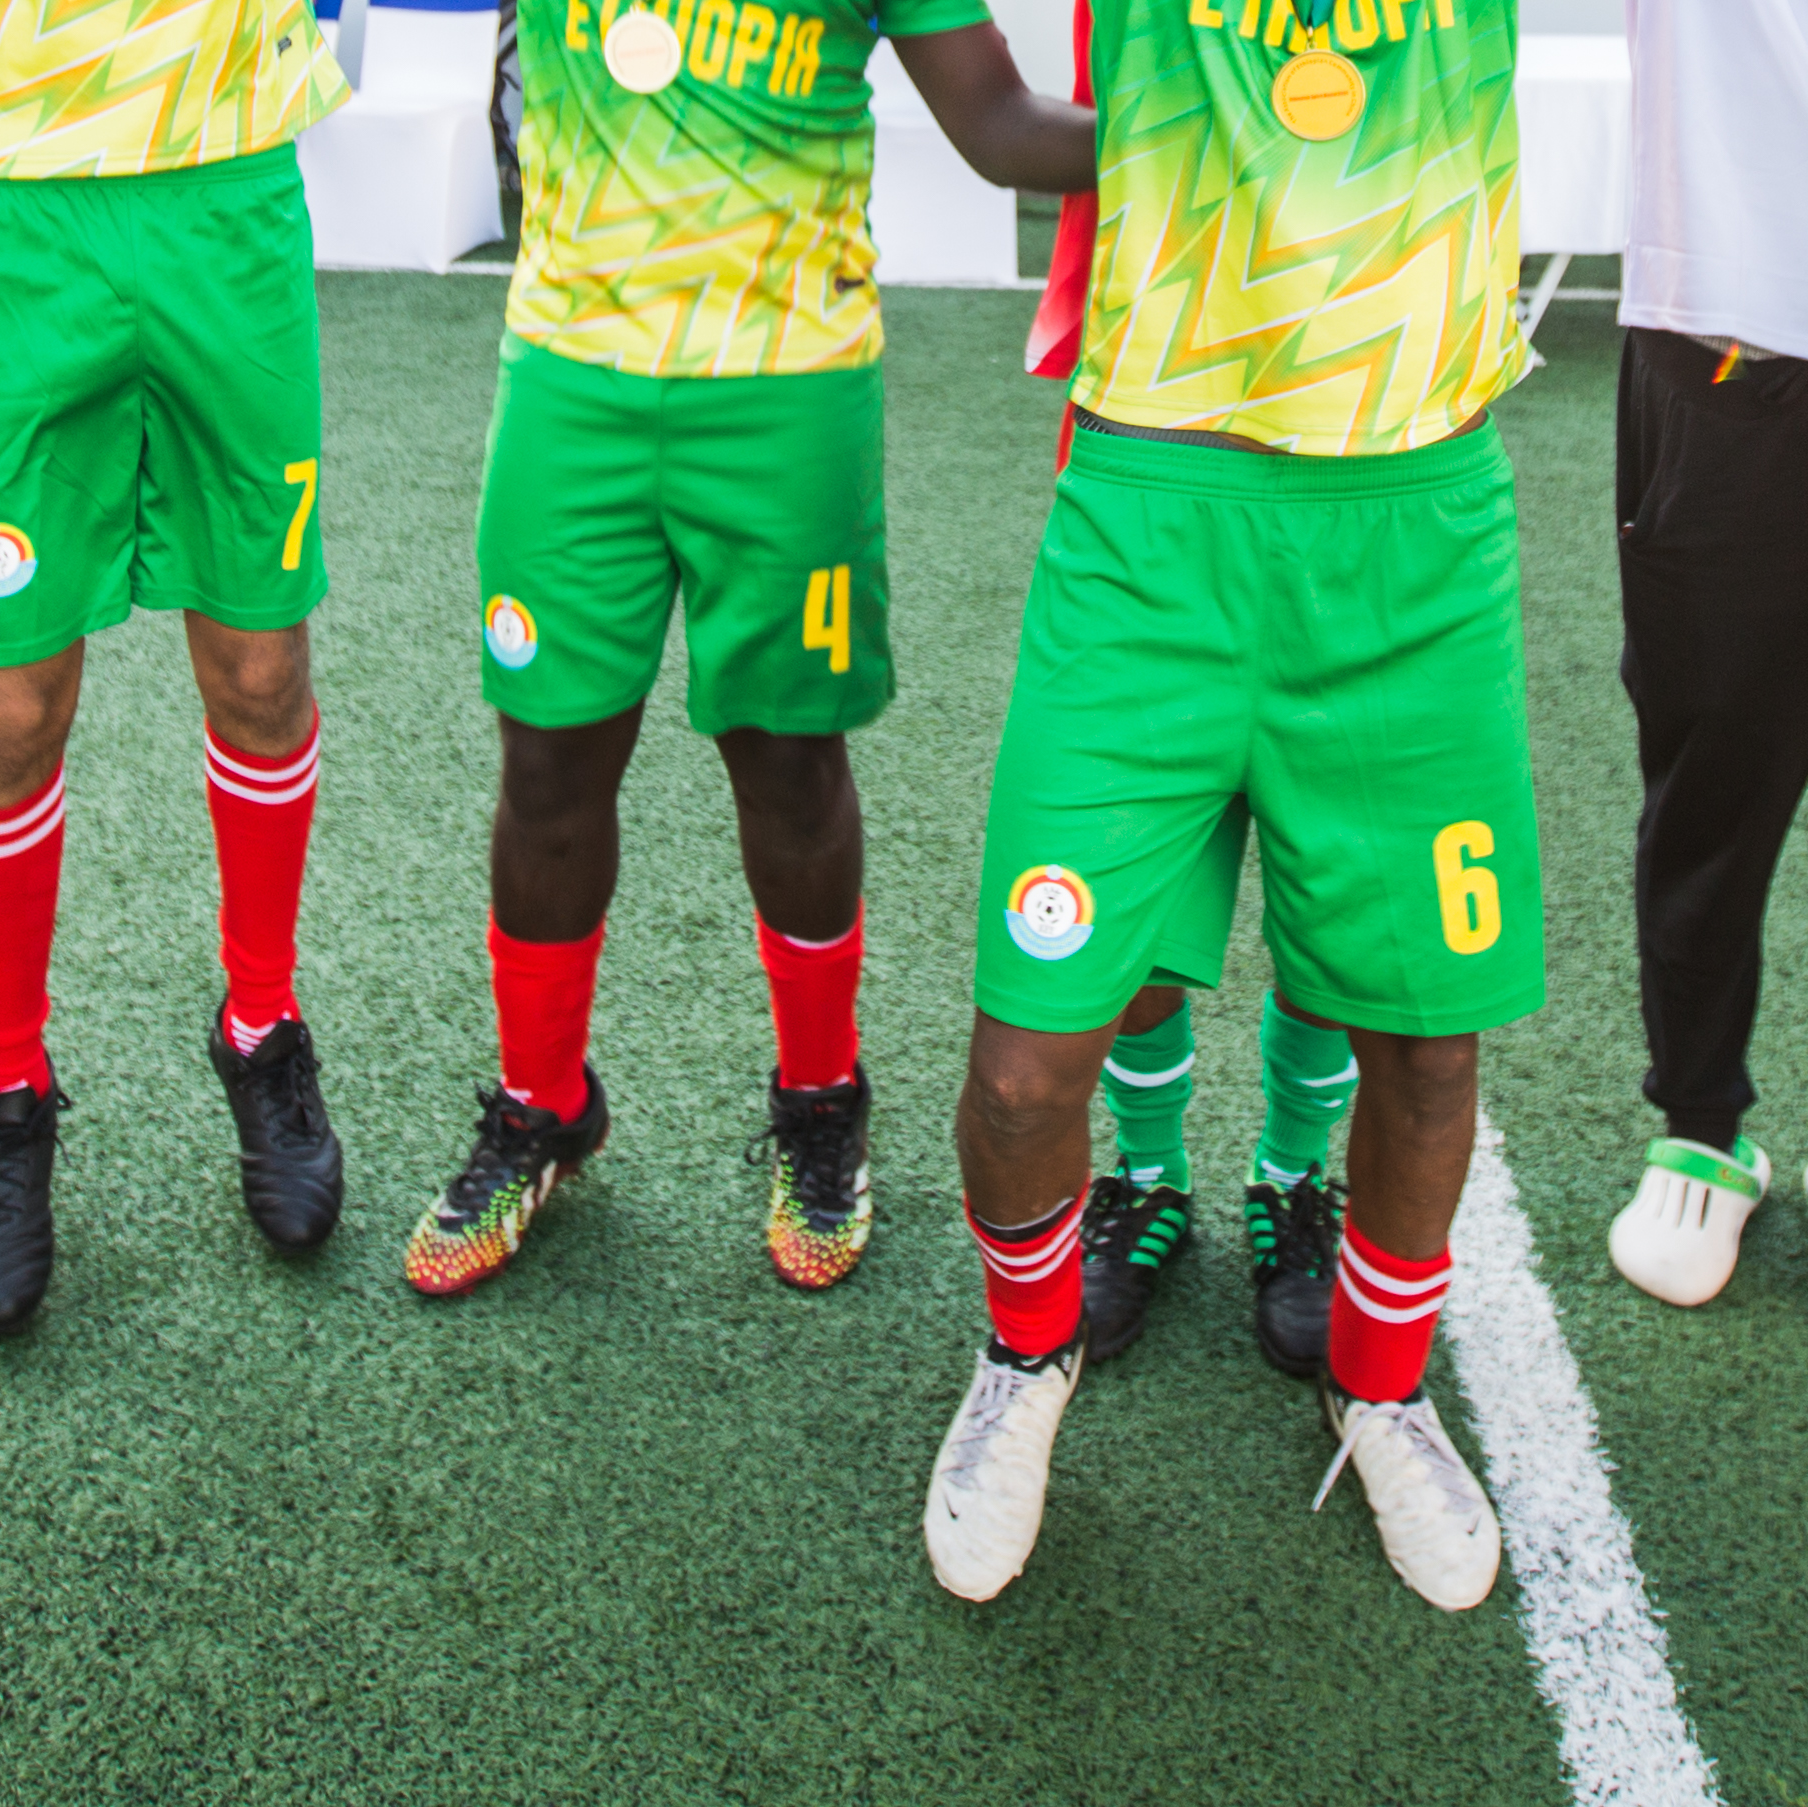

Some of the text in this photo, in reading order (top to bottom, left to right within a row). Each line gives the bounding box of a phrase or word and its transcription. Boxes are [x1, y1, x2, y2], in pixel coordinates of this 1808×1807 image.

[283, 458, 318, 571] 7
[802, 564, 851, 673] 4
[1432, 820, 1502, 955] 6
